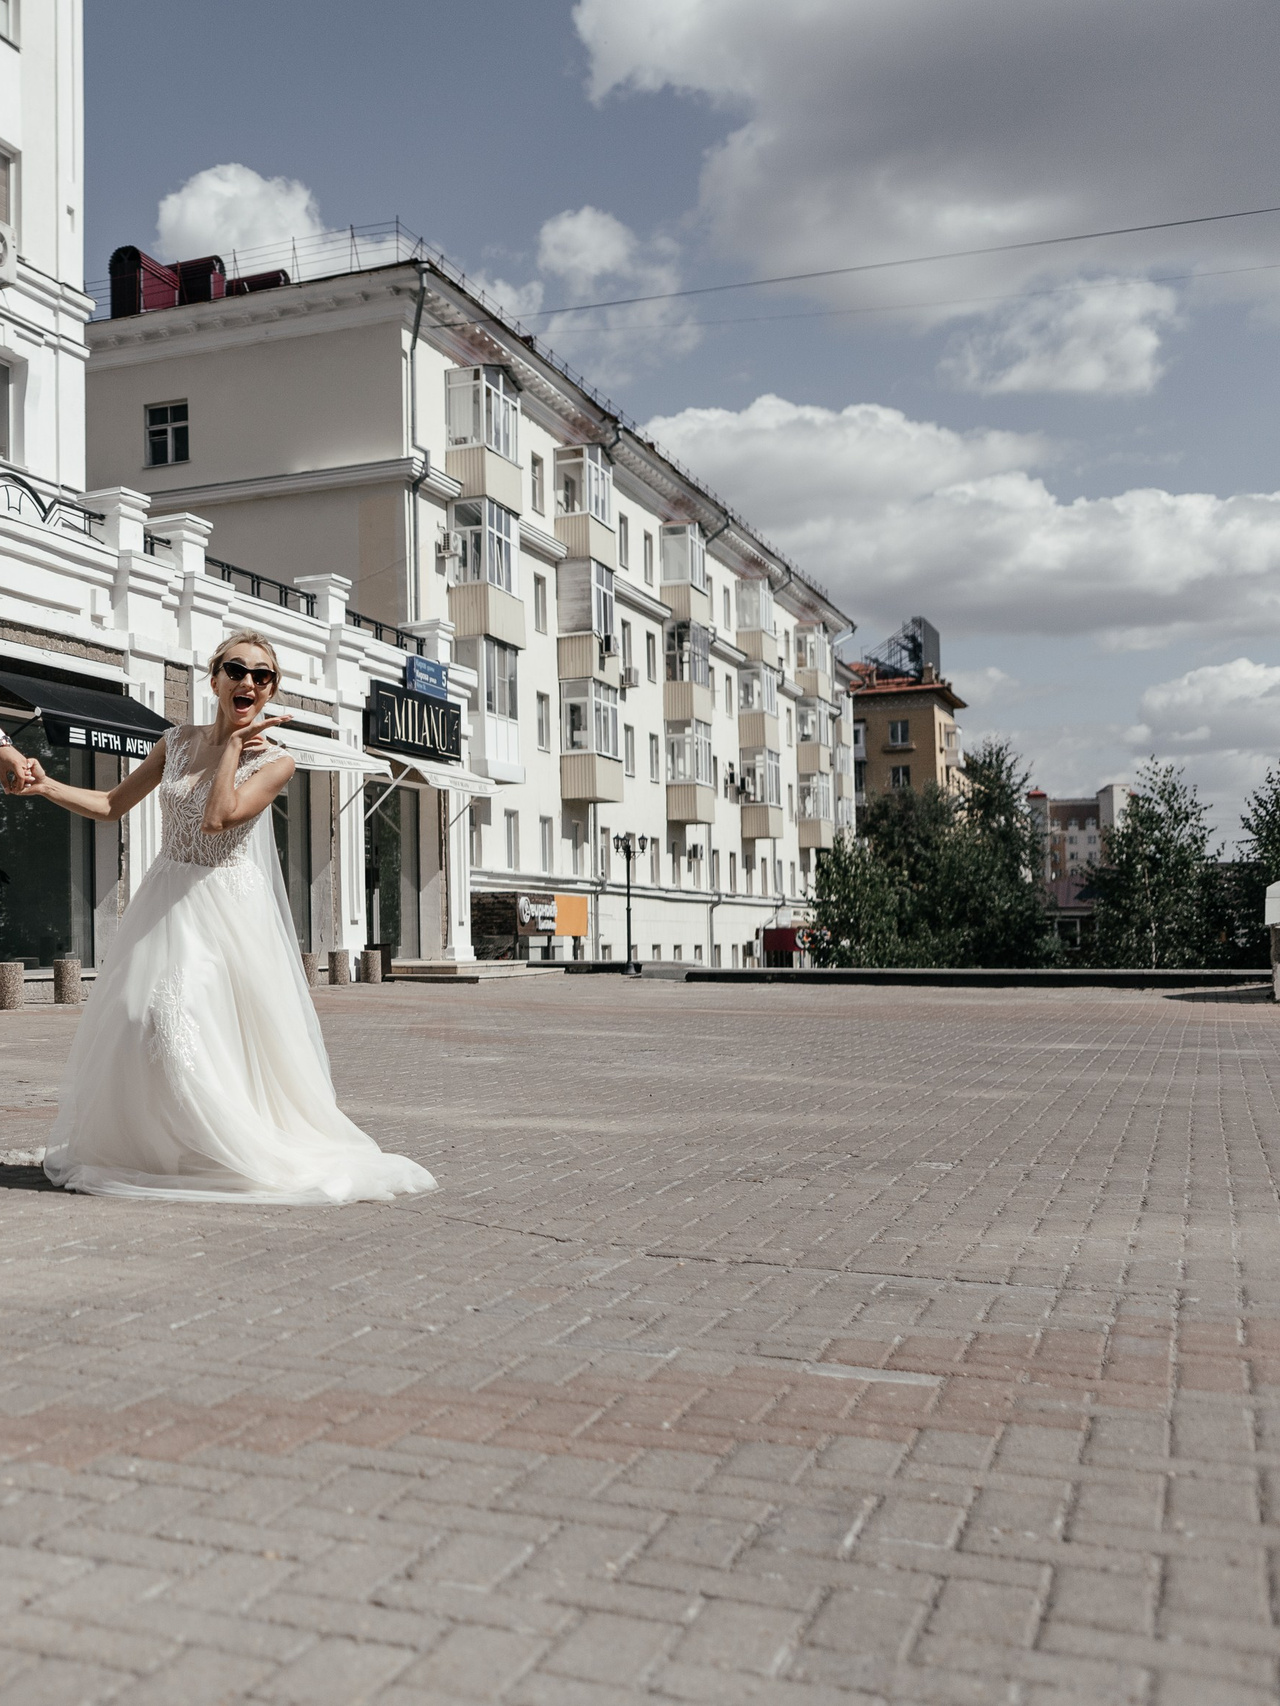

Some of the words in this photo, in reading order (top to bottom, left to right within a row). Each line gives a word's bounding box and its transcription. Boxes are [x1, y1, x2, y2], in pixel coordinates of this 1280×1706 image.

[441, 670, 448, 688] 5
[393, 697, 448, 751] MILANO
[91, 730, 121, 751] FIFTH
[125, 736, 156, 756] AVENU
